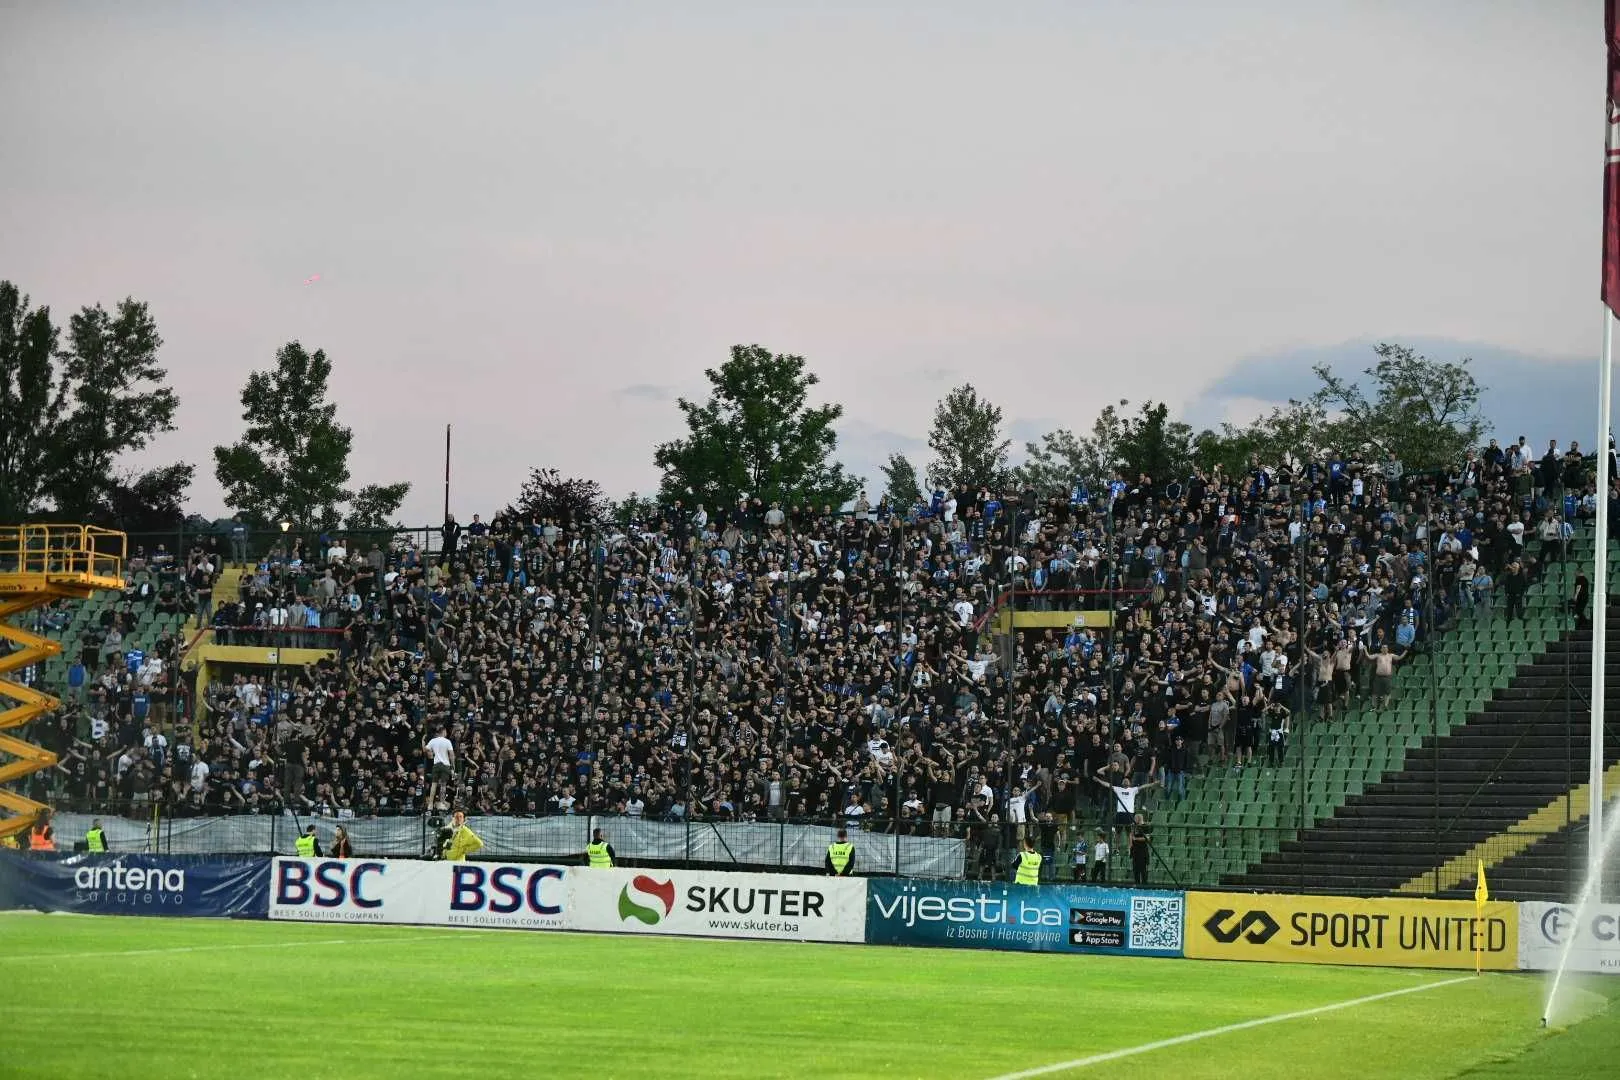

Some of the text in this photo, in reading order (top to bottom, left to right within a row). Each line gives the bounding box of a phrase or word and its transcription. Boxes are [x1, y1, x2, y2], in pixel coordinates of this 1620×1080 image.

[74, 861, 185, 892] antena
[276, 860, 385, 908] BSC
[450, 865, 566, 915] BSC
[686, 885, 825, 918] SKUTER
[299, 911, 342, 919] SOLUTION
[344, 912, 385, 920] COMPANY
[873, 886, 1062, 927] vijesti.ba
[474, 916, 518, 925] SOLUTION
[520, 918, 565, 927] COMPANY
[708, 918, 800, 933] www.skuter.ba
[1085, 915, 1121, 925] Google Play
[1290, 912, 1506, 952] SPORT UNITED
[946, 925, 955, 938] iz
[958, 925, 988, 940] Bosne
[998, 927, 1062, 944] Hercegovine
[1085, 936, 1120, 945] App Store
